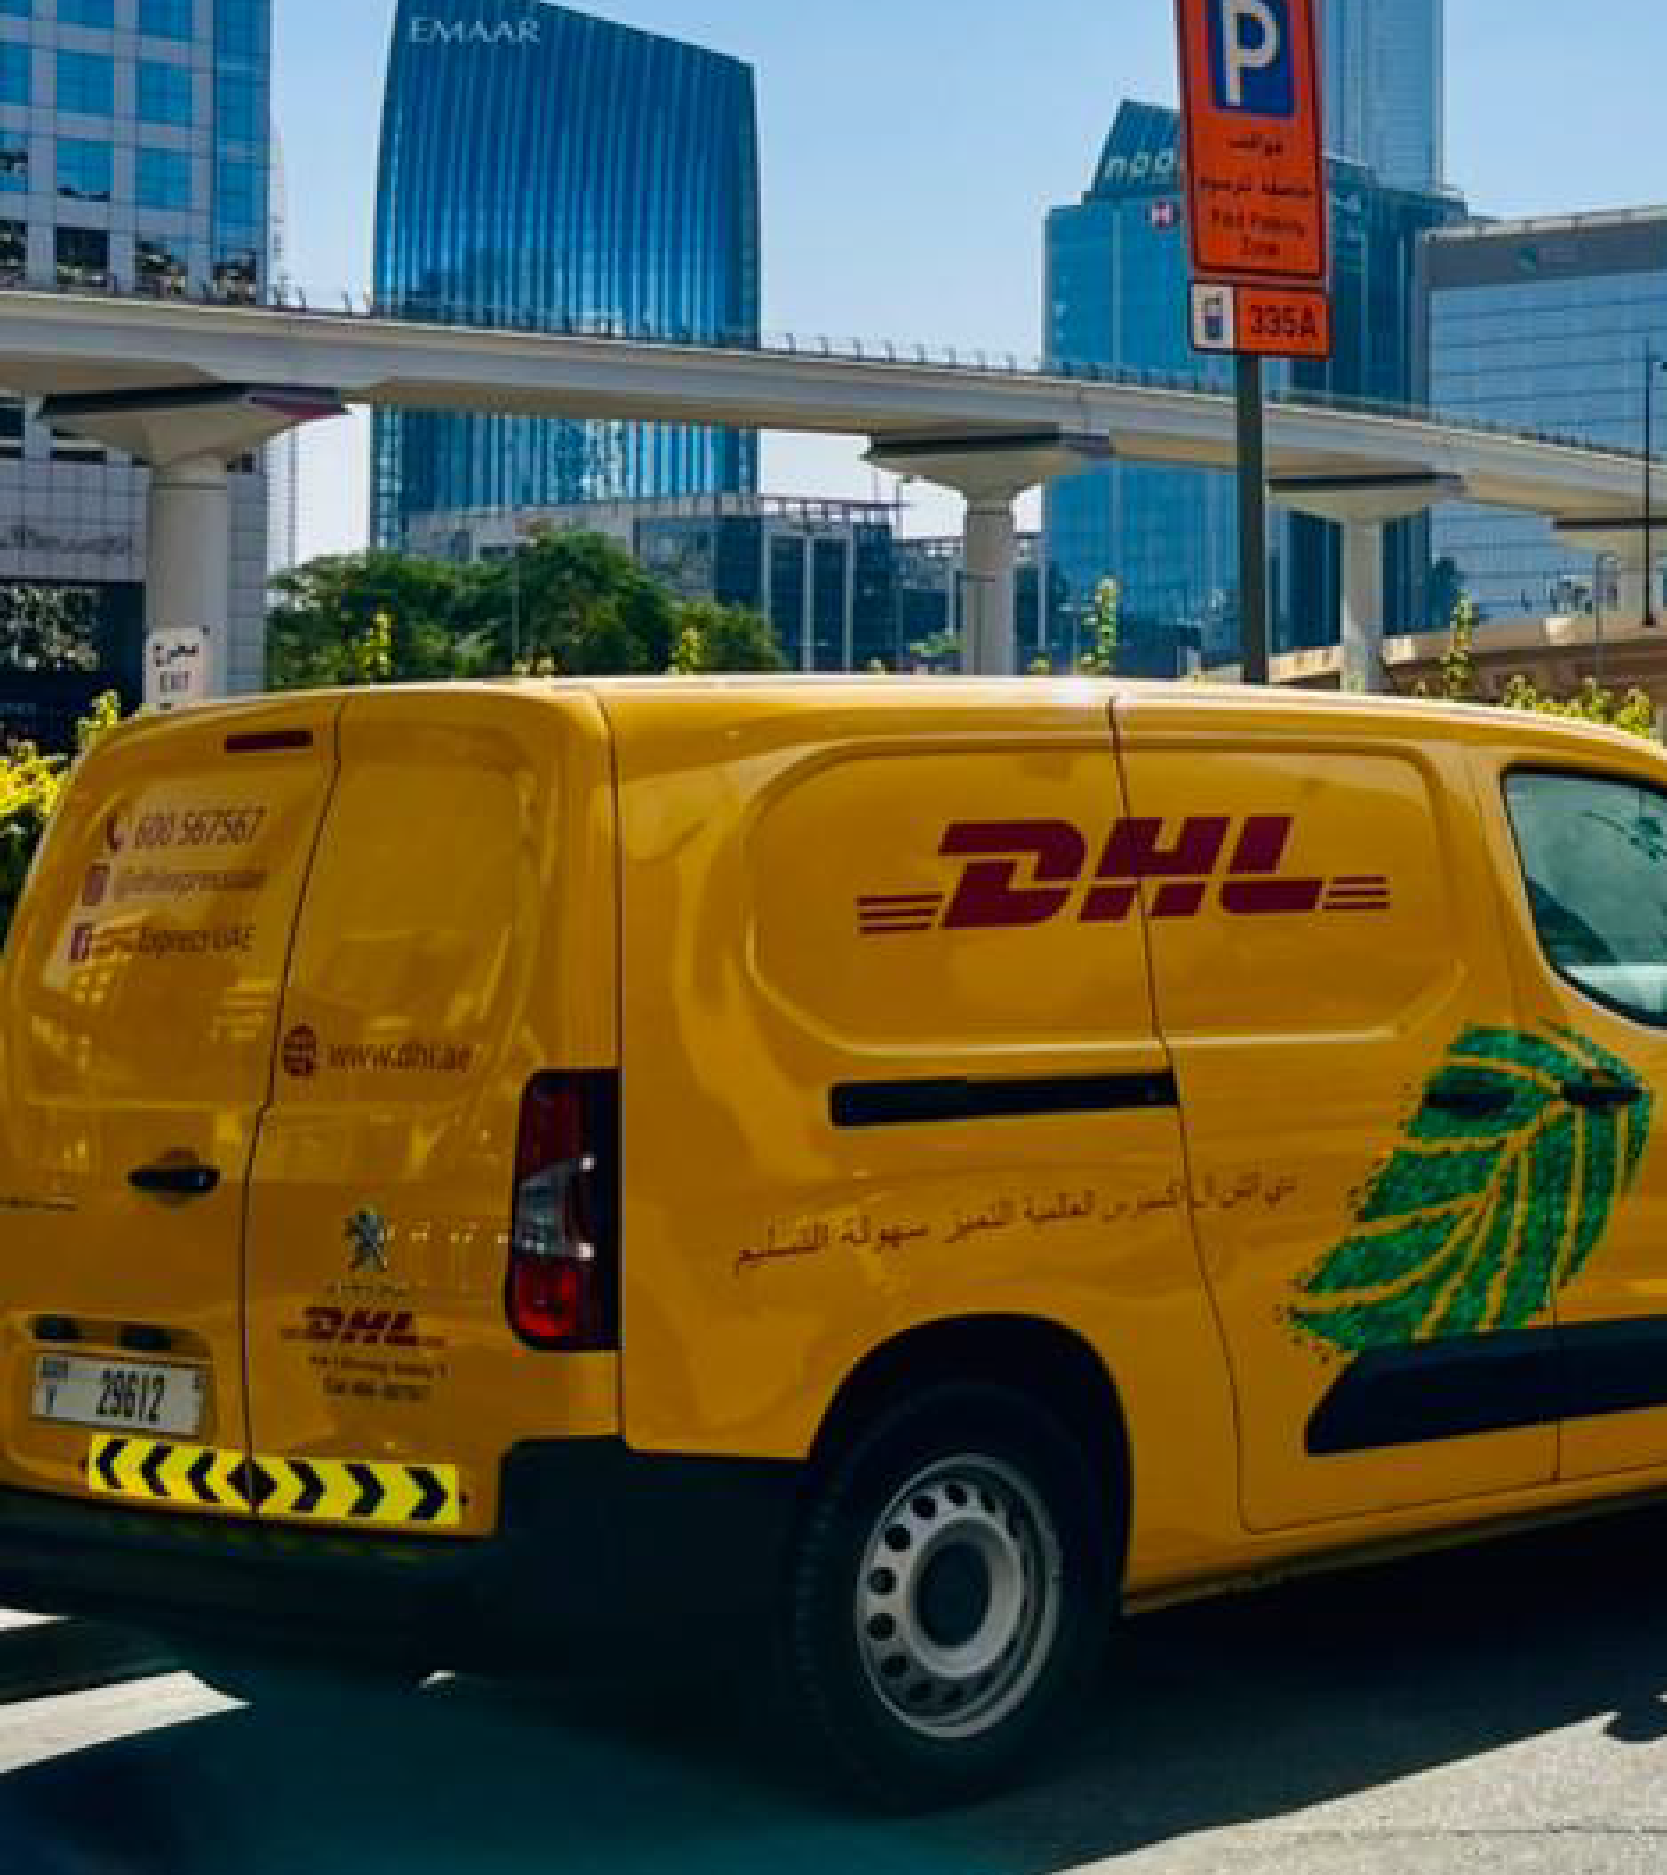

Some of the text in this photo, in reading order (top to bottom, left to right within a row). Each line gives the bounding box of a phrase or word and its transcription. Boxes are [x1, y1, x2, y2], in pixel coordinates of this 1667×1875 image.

[408, 16, 542, 45] EMAAR
[1221, 0, 1281, 107] P
[1103, 152, 1175, 177] noo
[1249, 303, 1317, 339] 335A
[158, 670, 191, 693] EXIT
[937, 813, 1324, 931] DHL
[302, 1305, 419, 1347] DHL
[95, 1367, 166, 1425] 29612
